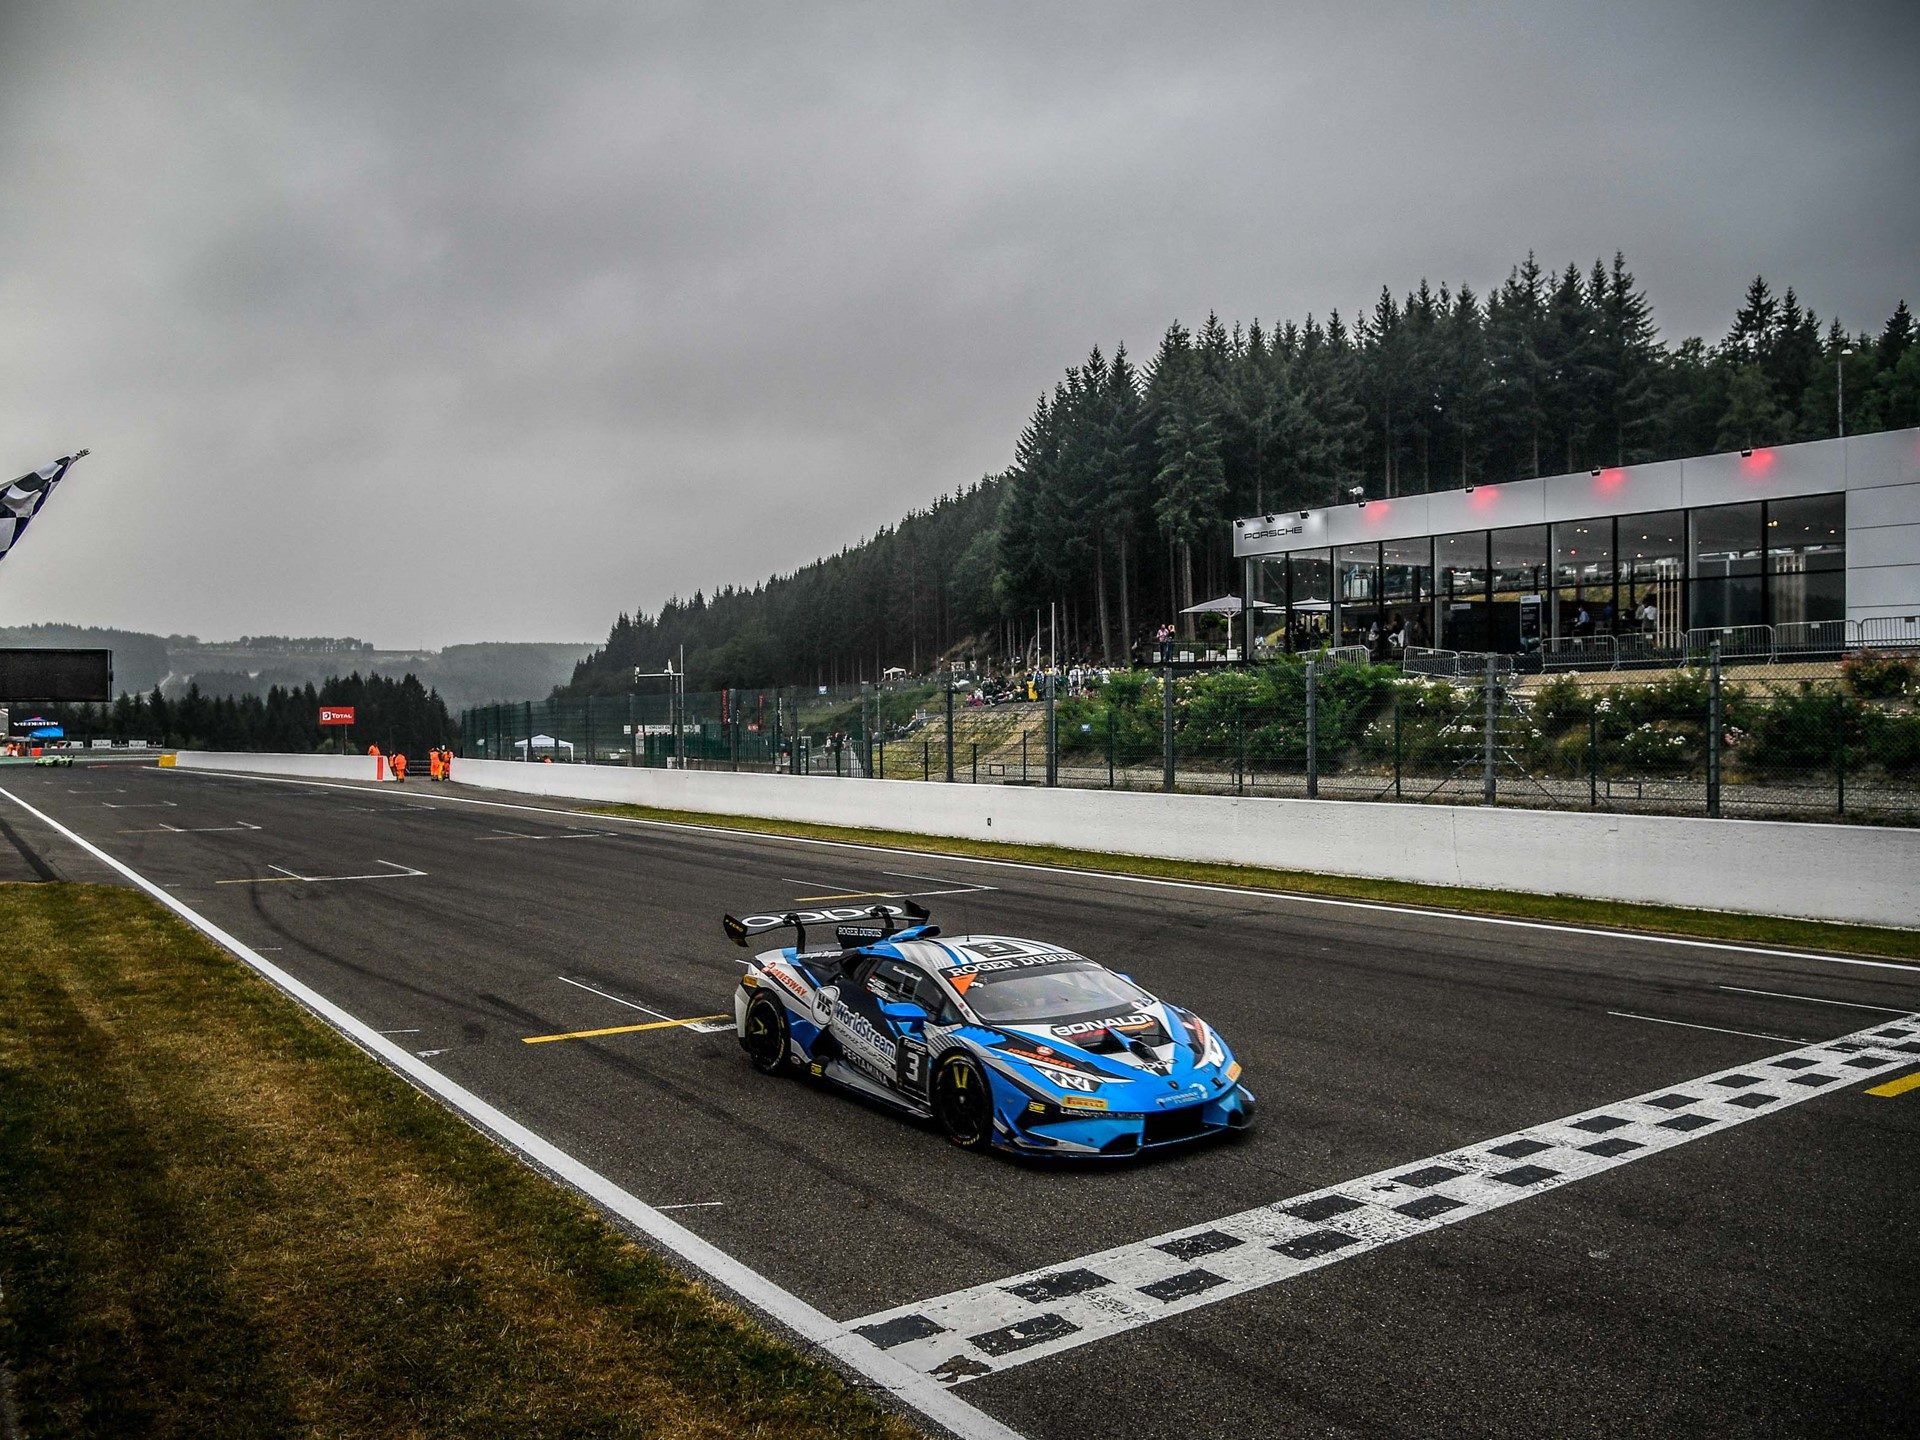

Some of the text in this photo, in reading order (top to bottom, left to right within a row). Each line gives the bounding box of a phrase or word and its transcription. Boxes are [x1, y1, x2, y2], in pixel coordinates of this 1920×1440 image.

[1244, 526, 1303, 540] PORSCHE
[838, 927, 882, 937] ROGER DUBUIS
[946, 953, 1084, 976] ROGER DUBUIS
[834, 1000, 897, 1061] WorldStream
[1053, 1014, 1154, 1036] BONALDI
[842, 1045, 890, 1087] PERTAMINA
[905, 1051, 920, 1081] 3
